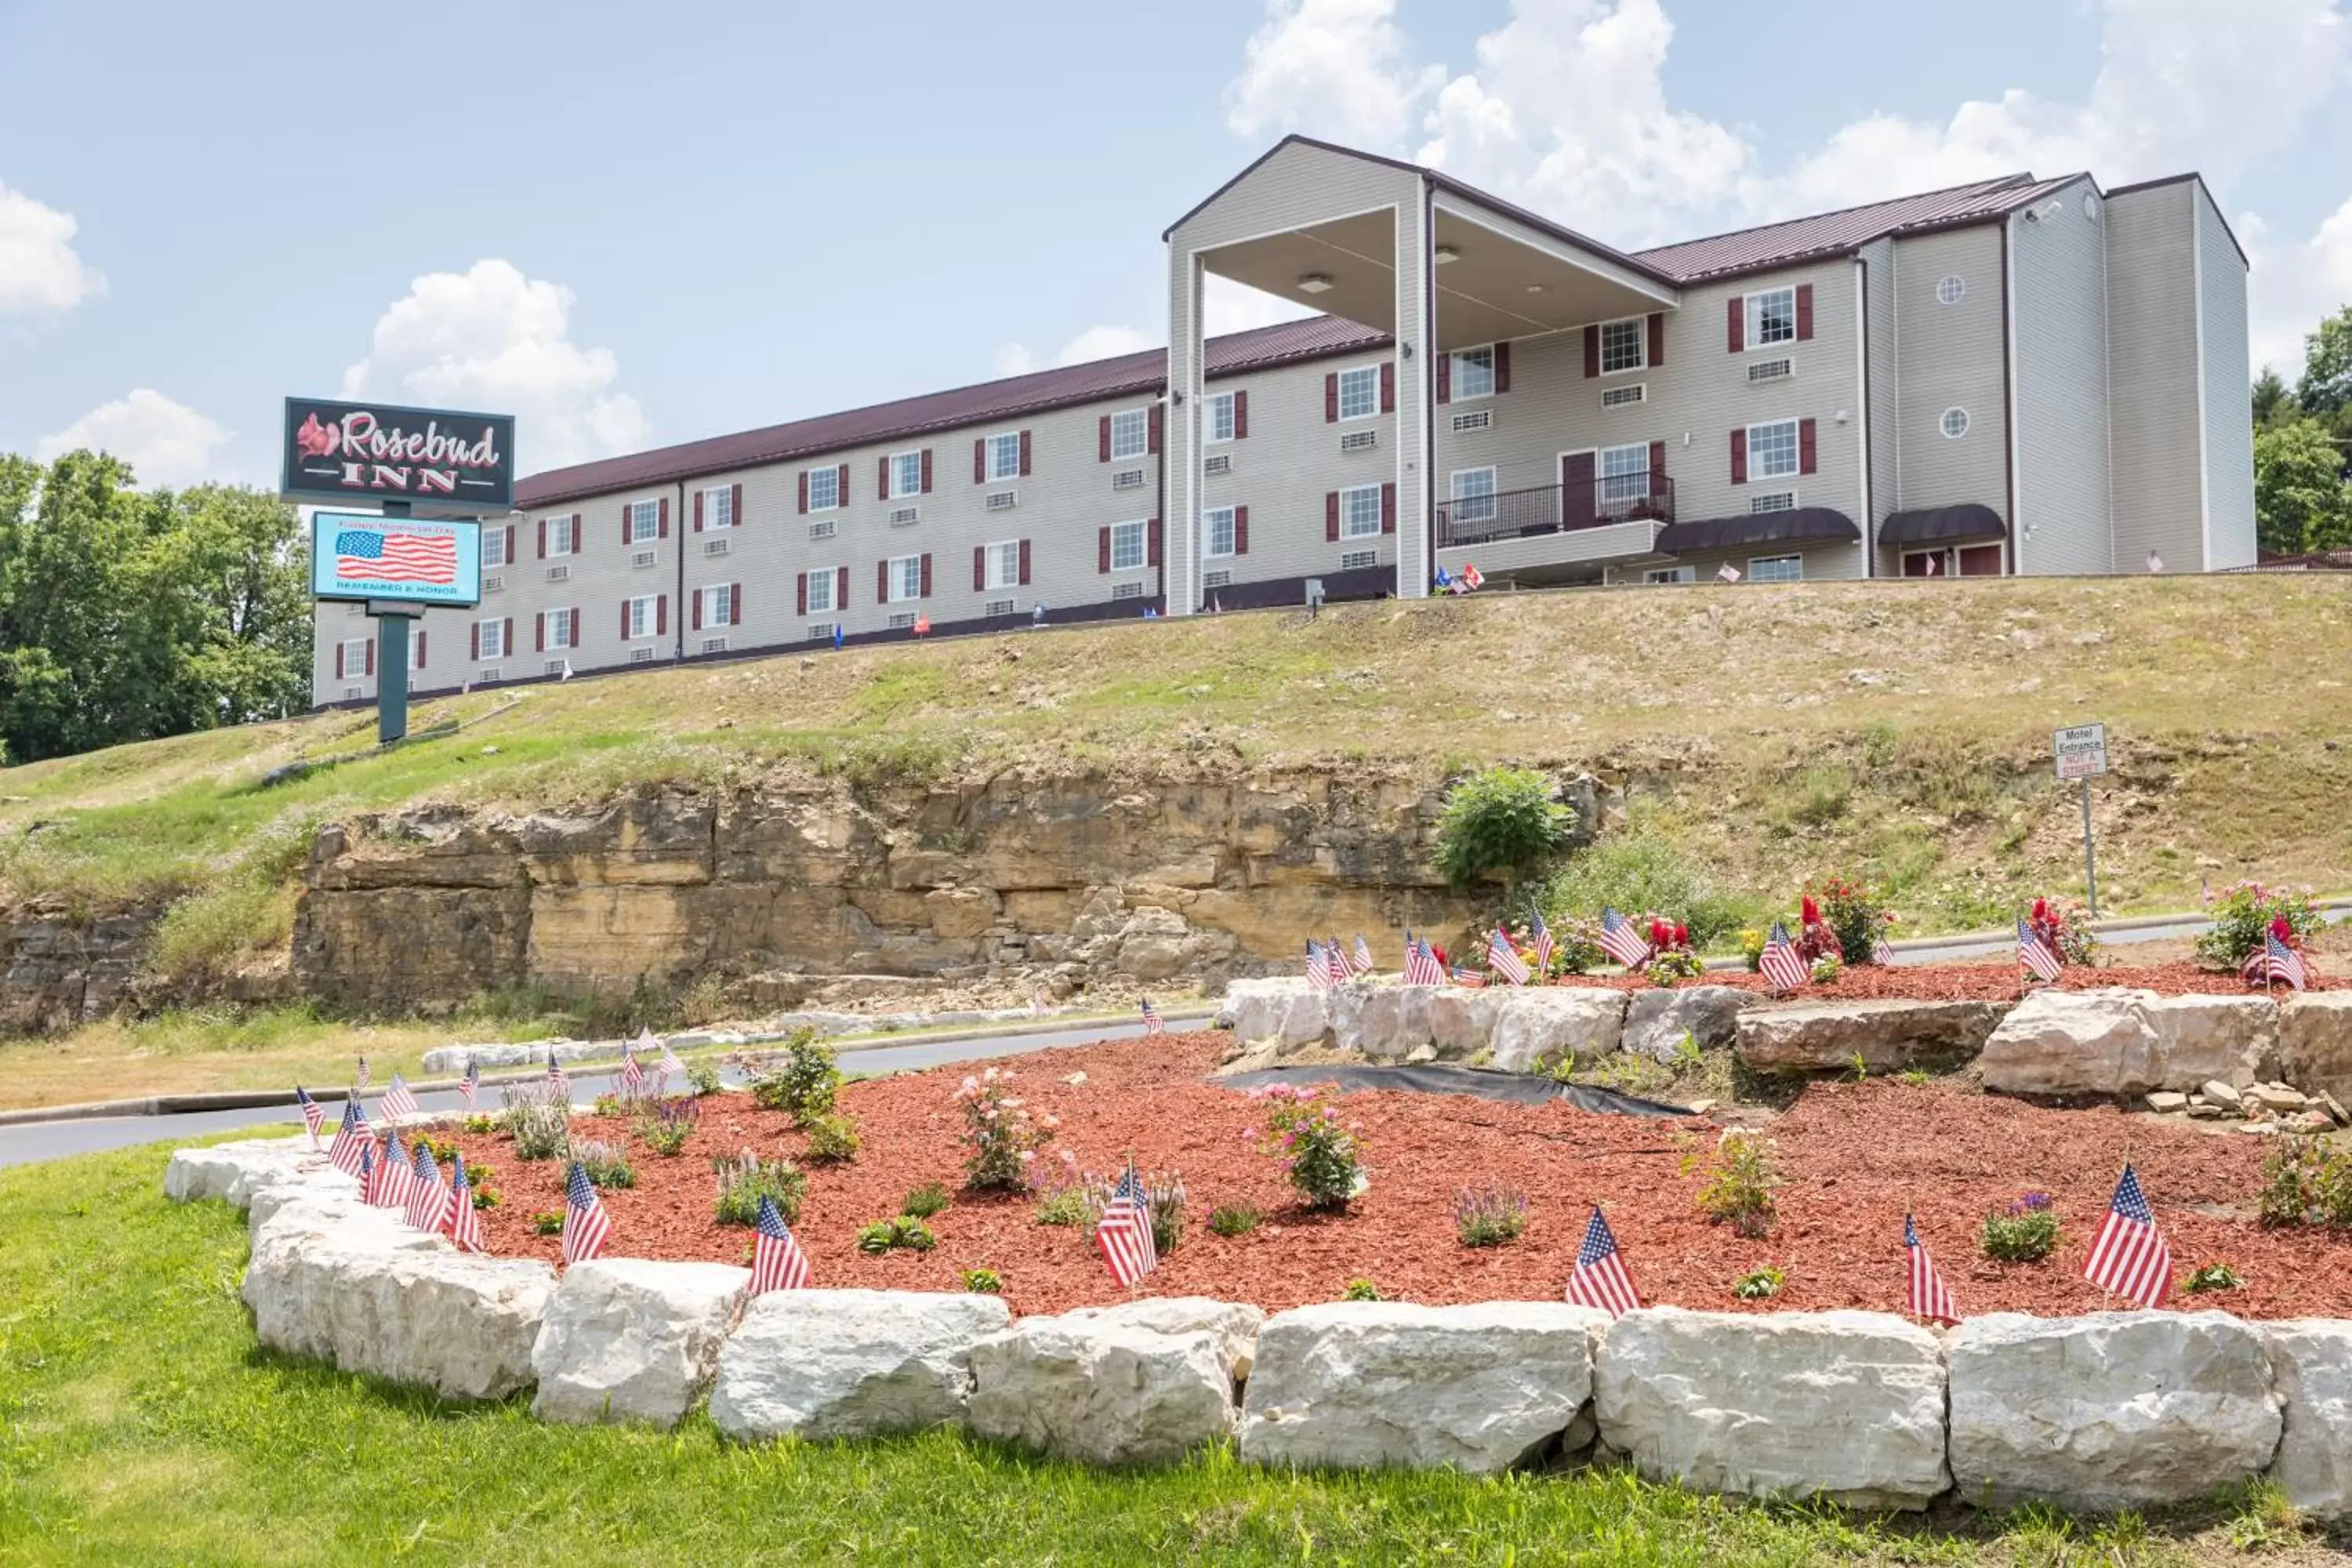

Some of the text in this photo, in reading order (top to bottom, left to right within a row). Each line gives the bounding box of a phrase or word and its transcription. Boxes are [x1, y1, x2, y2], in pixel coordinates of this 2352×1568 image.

[340, 412, 499, 467] Rosebud
[341, 462, 459, 493] INN
[336, 582, 402, 592] REMEMBER
[416, 586, 458, 595] HONOR
[2066, 728, 2092, 740] Motel
[2059, 741, 2101, 753] Entrance
